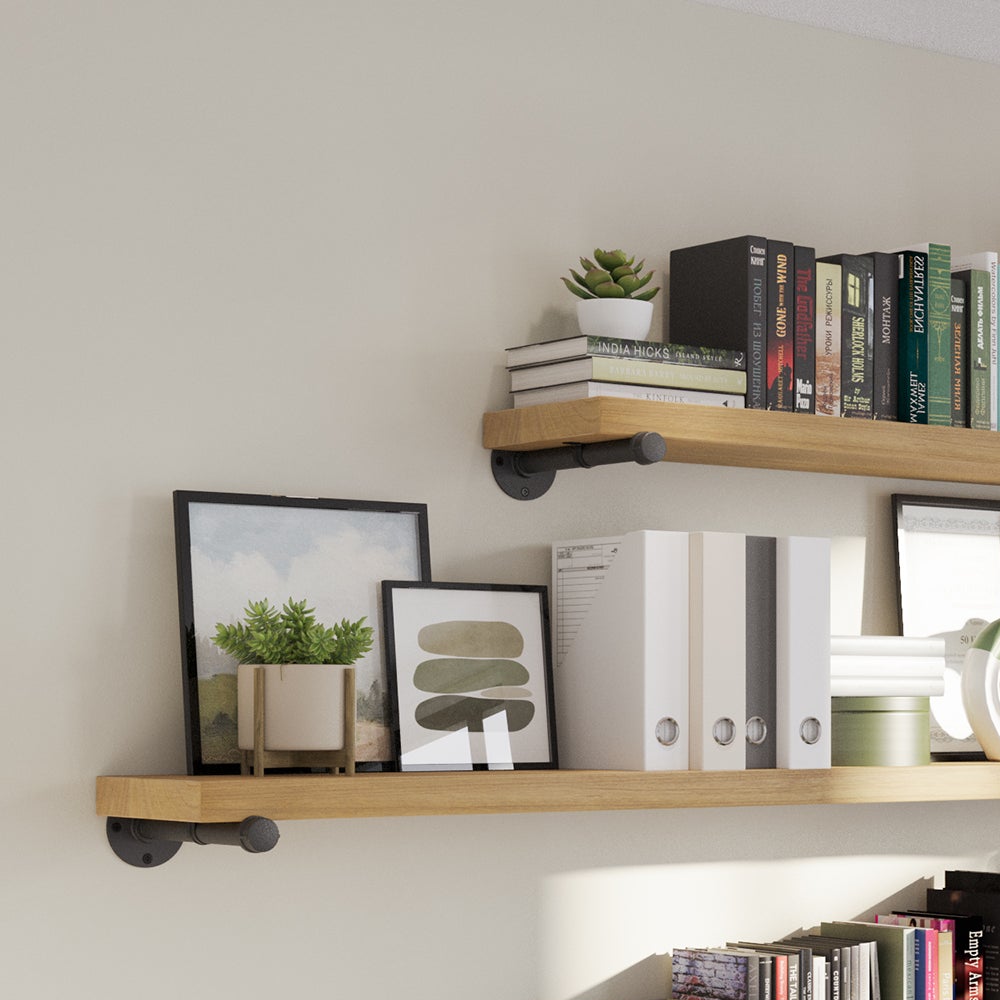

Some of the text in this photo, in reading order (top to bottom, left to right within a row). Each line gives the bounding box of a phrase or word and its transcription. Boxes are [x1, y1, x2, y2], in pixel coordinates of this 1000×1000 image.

[776, 253, 788, 338] GONE WIND
[796, 268, 813, 360] The Godfather
[881, 296, 891, 344] МОНТАЖ
[990, 317, 996, 326] by
[598, 342, 670, 359] INDIA HICKS
[676, 352, 699, 360] ISLAND
[752, 278, 762, 408] ПОБЕГ ИЗ ШОУШЕНКА
[825, 330, 833, 356] УРОКИ
[852, 316, 865, 383] SHERLOCK HOLMS
[796, 378, 812, 394] Mario
[965, 931, 982, 968] Empty
[789, 964, 797, 977] THE
[943, 973, 951, 995] Paris
